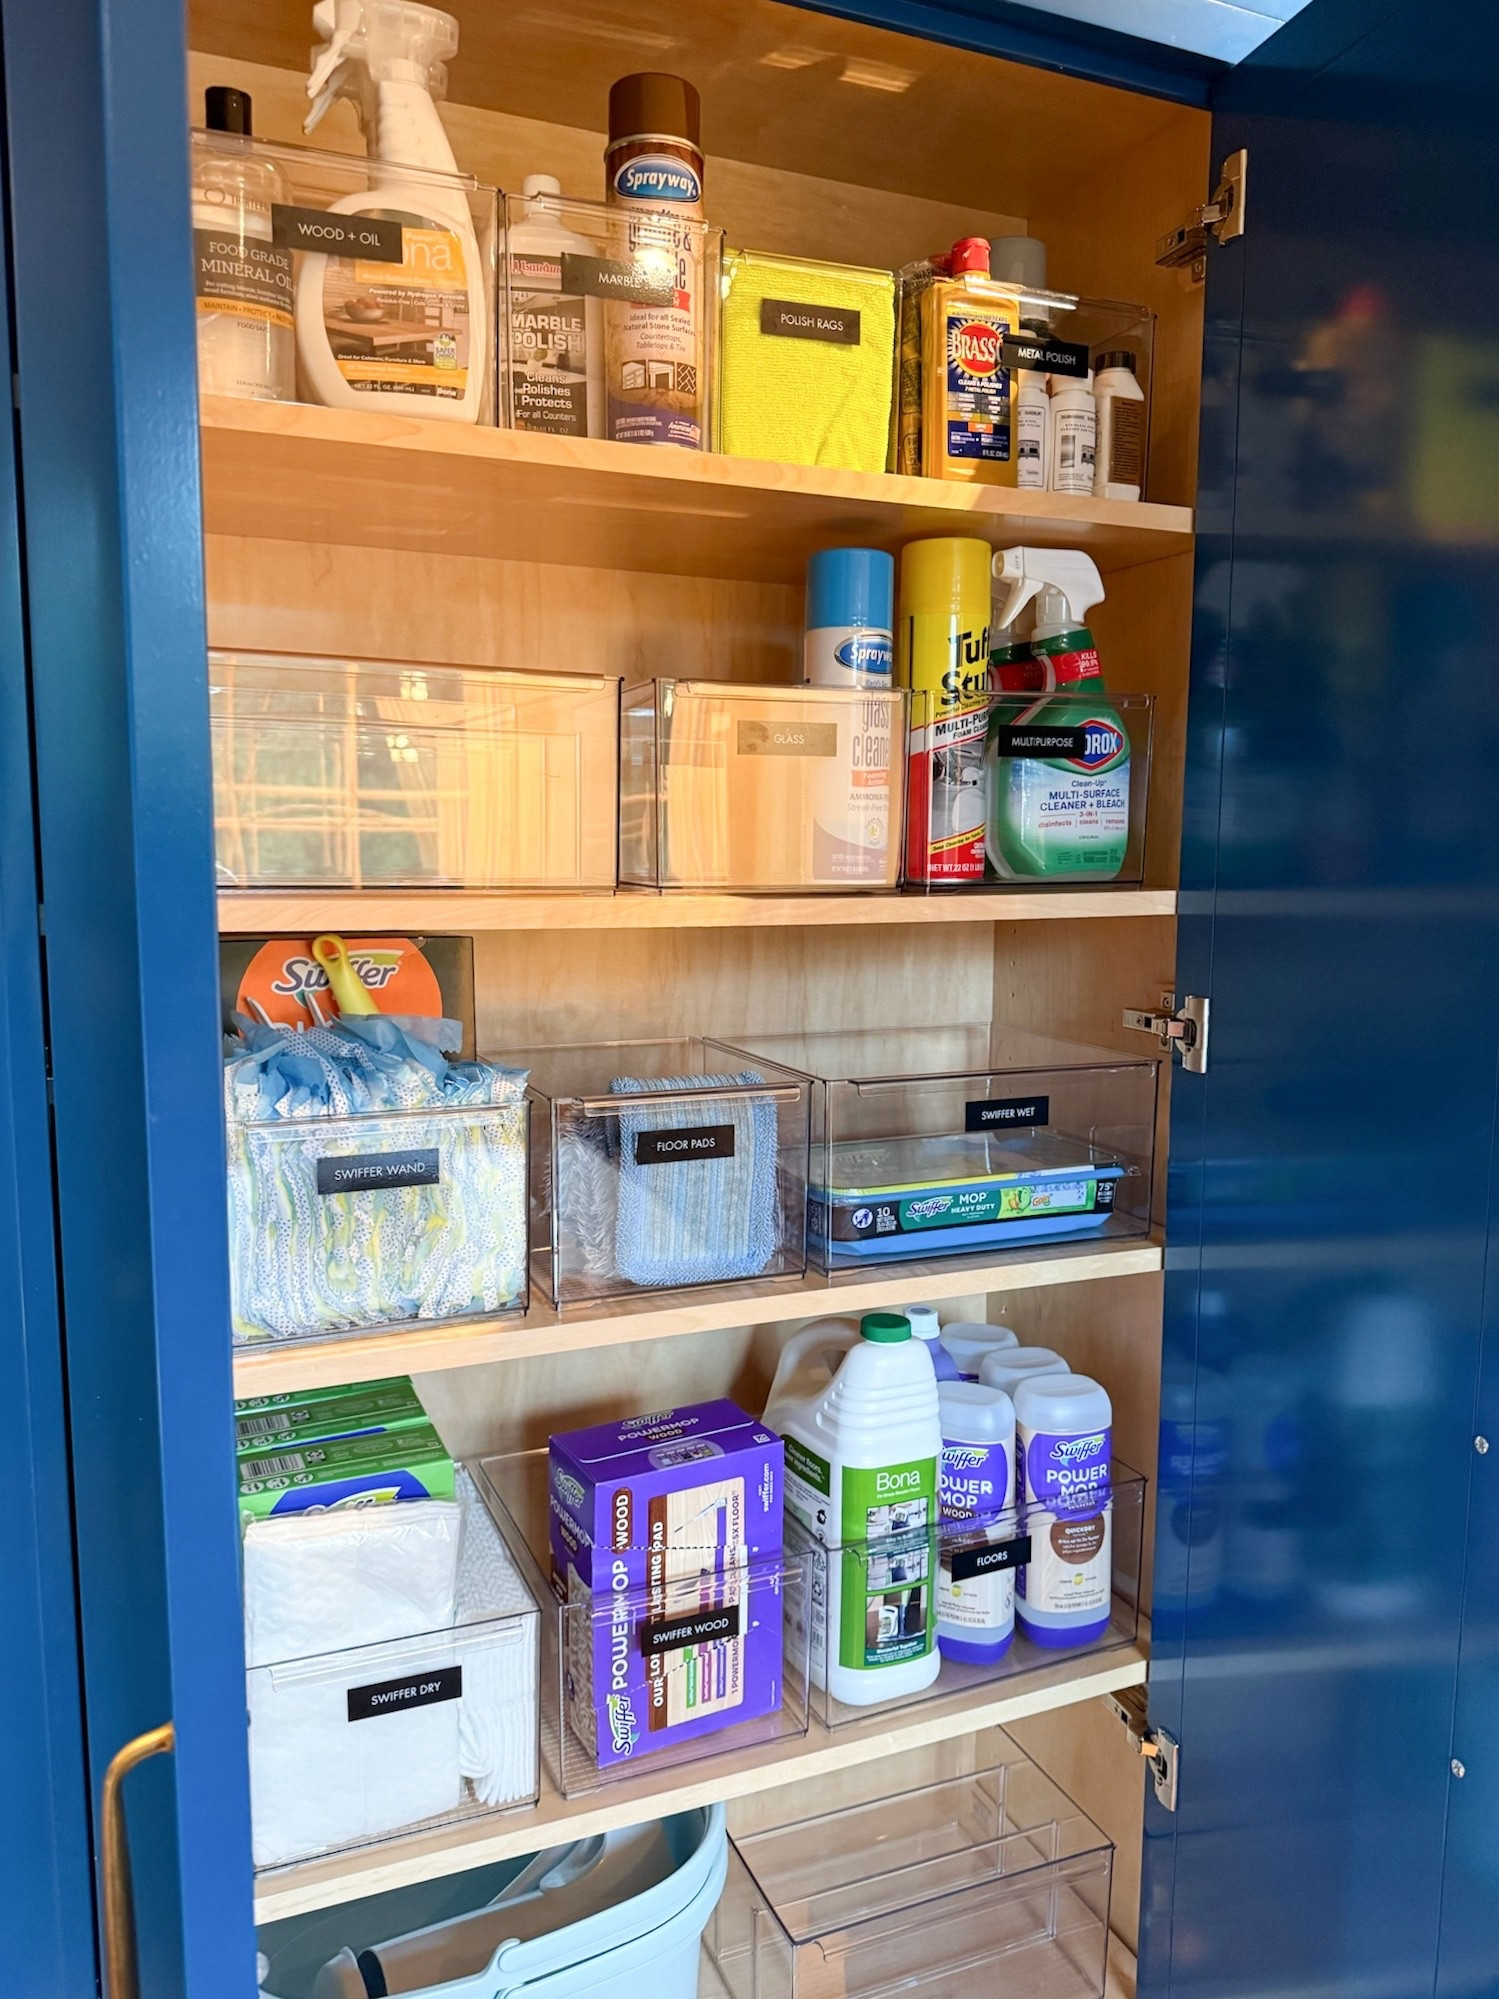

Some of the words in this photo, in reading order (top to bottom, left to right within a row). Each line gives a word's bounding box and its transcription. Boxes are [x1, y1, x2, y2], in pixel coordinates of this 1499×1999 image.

[626, 168, 696, 196] Sprayway
[298, 223, 344, 240] WOOD
[348, 232, 356, 240] +
[359, 232, 380, 246] OIL
[209, 241, 248, 258] FOOD
[250, 249, 290, 270] GRADE
[201, 258, 274, 284] MINERAL
[598, 272, 641, 288] MARBLE
[511, 313, 582, 332] MARBLE
[630, 313, 646, 321] Ideal
[648, 313, 659, 321] for
[670, 315, 691, 326] Sealed
[780, 313, 815, 328] POLISH
[816, 318, 844, 332] RAGS
[623, 322, 648, 332] Natural
[650, 322, 670, 331] Stone
[671, 324, 697, 337] Surfaces
[512, 332, 583, 352] POLISH
[1017, 347, 1046, 361] METAL
[1045, 351, 1076, 366] POLISH
[526, 371, 567, 384] Cleans
[437, 387, 457, 397] Bona
[522, 383, 571, 397] Polishes
[521, 395, 573, 409] Protects
[516, 410, 531, 418] For
[532, 410, 540, 418] all
[542, 411, 577, 422] Counters
[1080, 651, 1097, 660] KILLS
[773, 734, 805, 745] GLASS
[953, 729, 972, 740] FOAM
[1011, 737, 1074, 748] MULTIPURPOSE
[1071, 780, 1104, 788] Clean-Up
[1049, 789, 1120, 801] MULTI-SURFACE
[1040, 801, 1087, 812] CLEANER
[1096, 799, 1126, 809] BLEACH
[1038, 820, 1072, 829] disinfects
[927, 864, 942, 872] NET
[274, 958, 397, 992] Swfer
[981, 1108, 1015, 1121] SWIFFER
[1016, 1106, 1036, 1118] WET
[656, 1139, 689, 1152] FLOOR
[691, 1137, 716, 1150] PADS
[334, 1166, 383, 1181] SWIFFER
[386, 1162, 425, 1176] WAND
[959, 1192, 987, 1205] MOP
[877, 1207, 891, 1217] 10
[906, 1200, 952, 1219] Swiffer
[951, 1205, 974, 1215] HEAVY
[976, 1203, 996, 1212] DUTY
[621, 1410, 675, 1431] Swiffer
[617, 1417, 699, 1442] POWERMOP
[648, 1428, 682, 1440] WOOD
[1050, 1440, 1105, 1462] Swiffer
[943, 1451, 988, 1469] wiffer
[876, 1470, 921, 1492] Bona
[1046, 1463, 1107, 1484] POWER
[761, 1462, 771, 1512] swiffer.com
[1060, 1481, 1098, 1497] MOP
[940, 1490, 978, 1509] MOP
[731, 1494, 740, 1525] FLOOR
[943, 1507, 973, 1520] WOOD
[615, 1495, 629, 1547] WOOD
[652, 1521, 663, 1552] PAD
[1064, 1525, 1096, 1535] QUICKDRY
[976, 1551, 1009, 1567] FLOORS
[652, 1626, 693, 1645] SWIFFER
[694, 1617, 729, 1634] WOOD
[731, 1640, 739, 1688] POWERMO
[371, 1687, 417, 1706] SWIFFER
[419, 1681, 441, 1696] DRY
[653, 1679, 664, 1707] OUR
[611, 1695, 637, 1756] Swiffer
